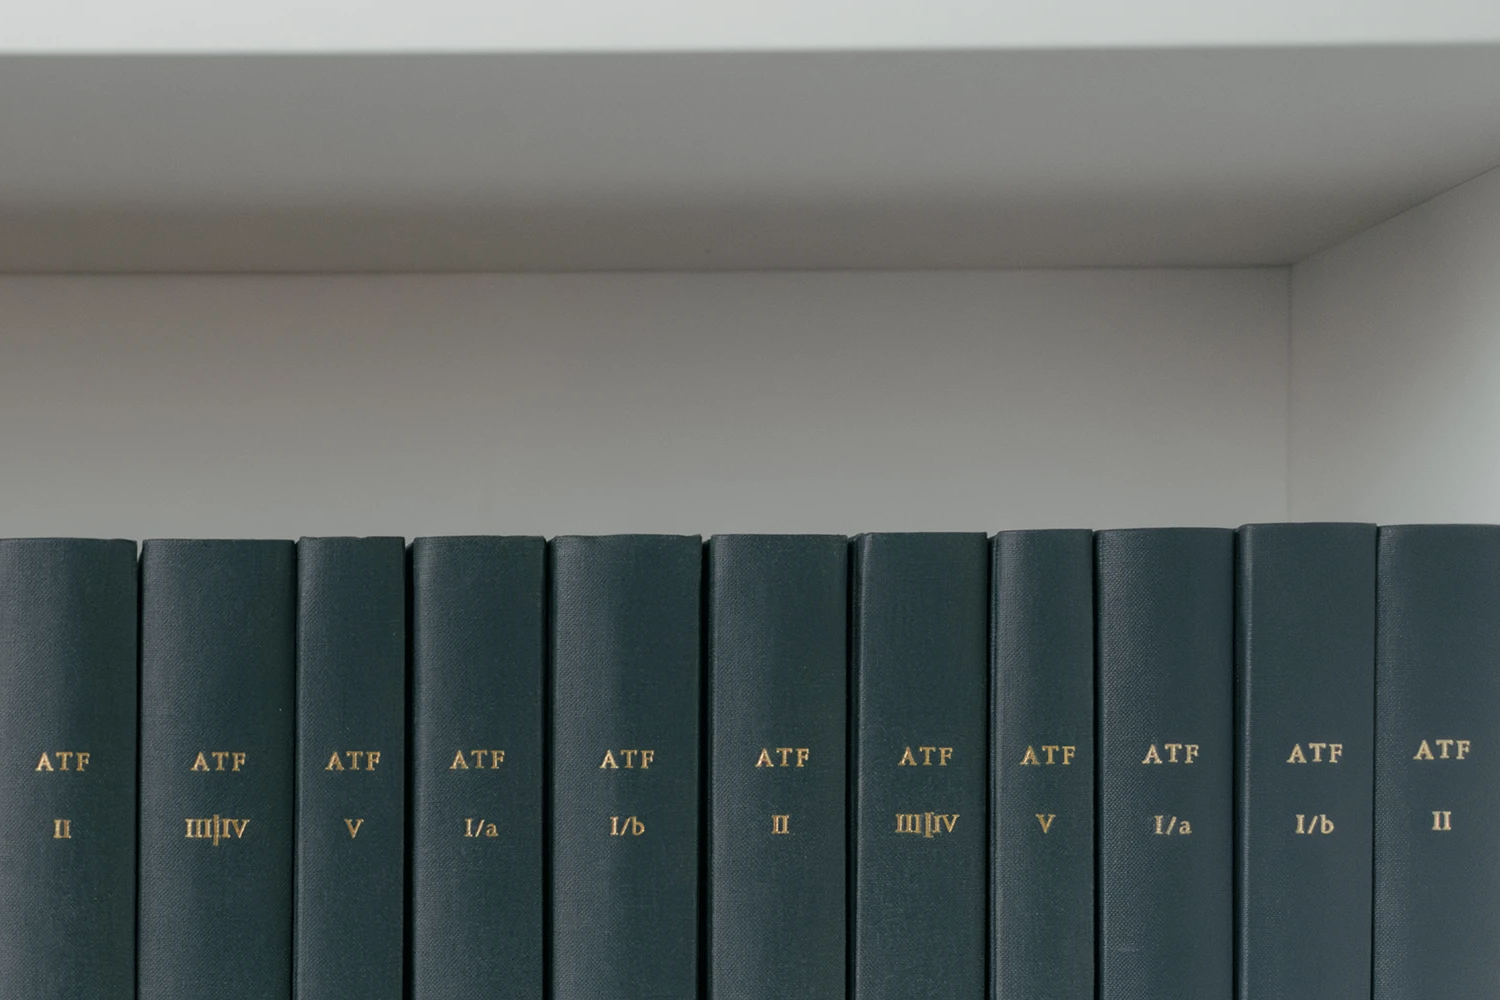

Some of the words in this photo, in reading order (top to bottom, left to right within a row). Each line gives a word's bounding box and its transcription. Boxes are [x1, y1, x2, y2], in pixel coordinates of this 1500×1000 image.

[449, 749, 506, 770] ATF
[599, 749, 655, 770] ATF
[754, 747, 810, 768] ATF
[897, 745, 954, 767] ATF
[1019, 744, 1076, 766] ATF
[1141, 742, 1200, 765] ATF
[1285, 742, 1343, 764] ATF
[1412, 738, 1471, 761] ATF
[35, 751, 91, 772] ATF
[190, 751, 247, 772] ATF
[324, 750, 381, 772] ATF
[53, 818, 72, 840] II
[343, 818, 365, 839] V
[464, 817, 499, 838] I/a
[609, 815, 646, 837] I/b
[770, 814, 790, 835] II
[1035, 813, 1057, 834] V
[1153, 814, 1193, 836] I/a
[1295, 813, 1335, 835] I/b
[1431, 810, 1452, 831] II
